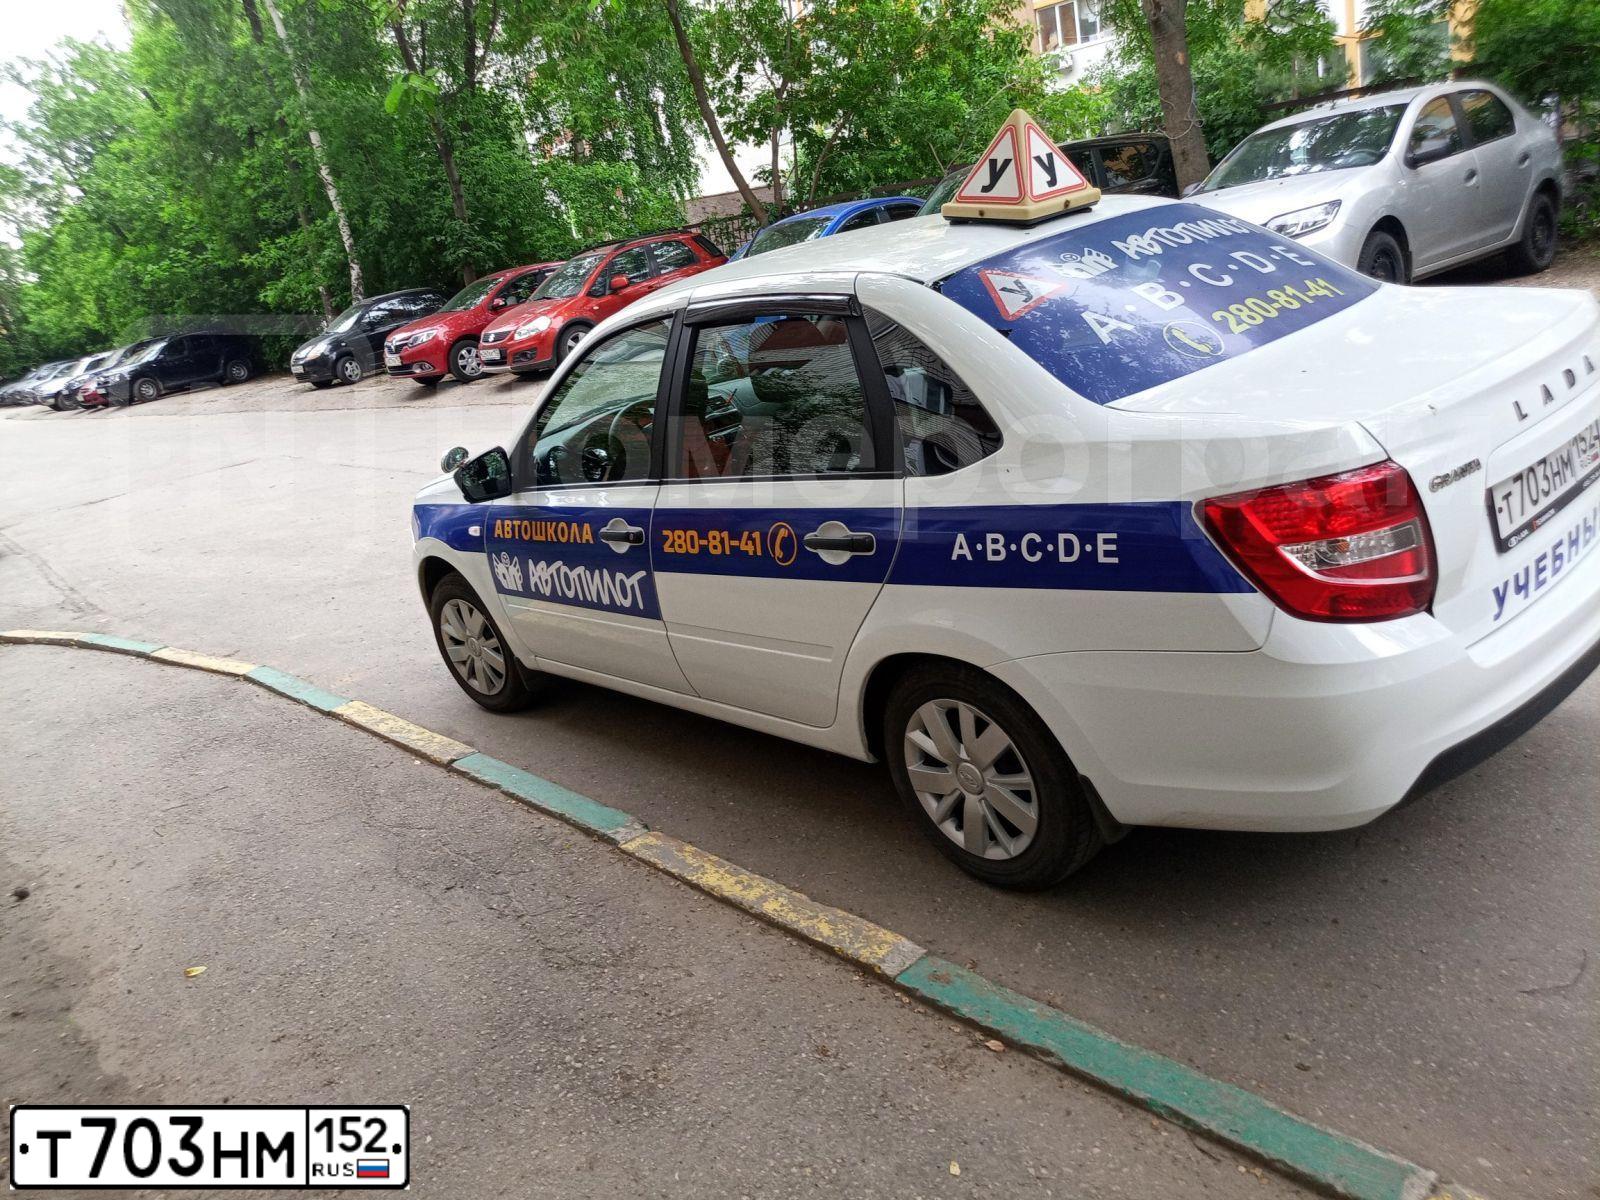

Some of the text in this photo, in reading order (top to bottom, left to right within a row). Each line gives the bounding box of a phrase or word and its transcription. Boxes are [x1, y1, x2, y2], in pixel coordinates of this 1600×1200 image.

[980, 158, 1012, 193] У
[1033, 152, 1057, 187] У
[999, 278, 1033, 303] У
[1212, 277, 1345, 335] 280-81-41
[1512, 354, 1595, 422] LADA
[493, 519, 594, 545] АВТОШКОЛА
[661, 529, 762, 557] 280-81-41
[1492, 502, 1600, 622] УЧЕБНЫ
[528, 558, 646, 610] АВТОПИЛОТ
